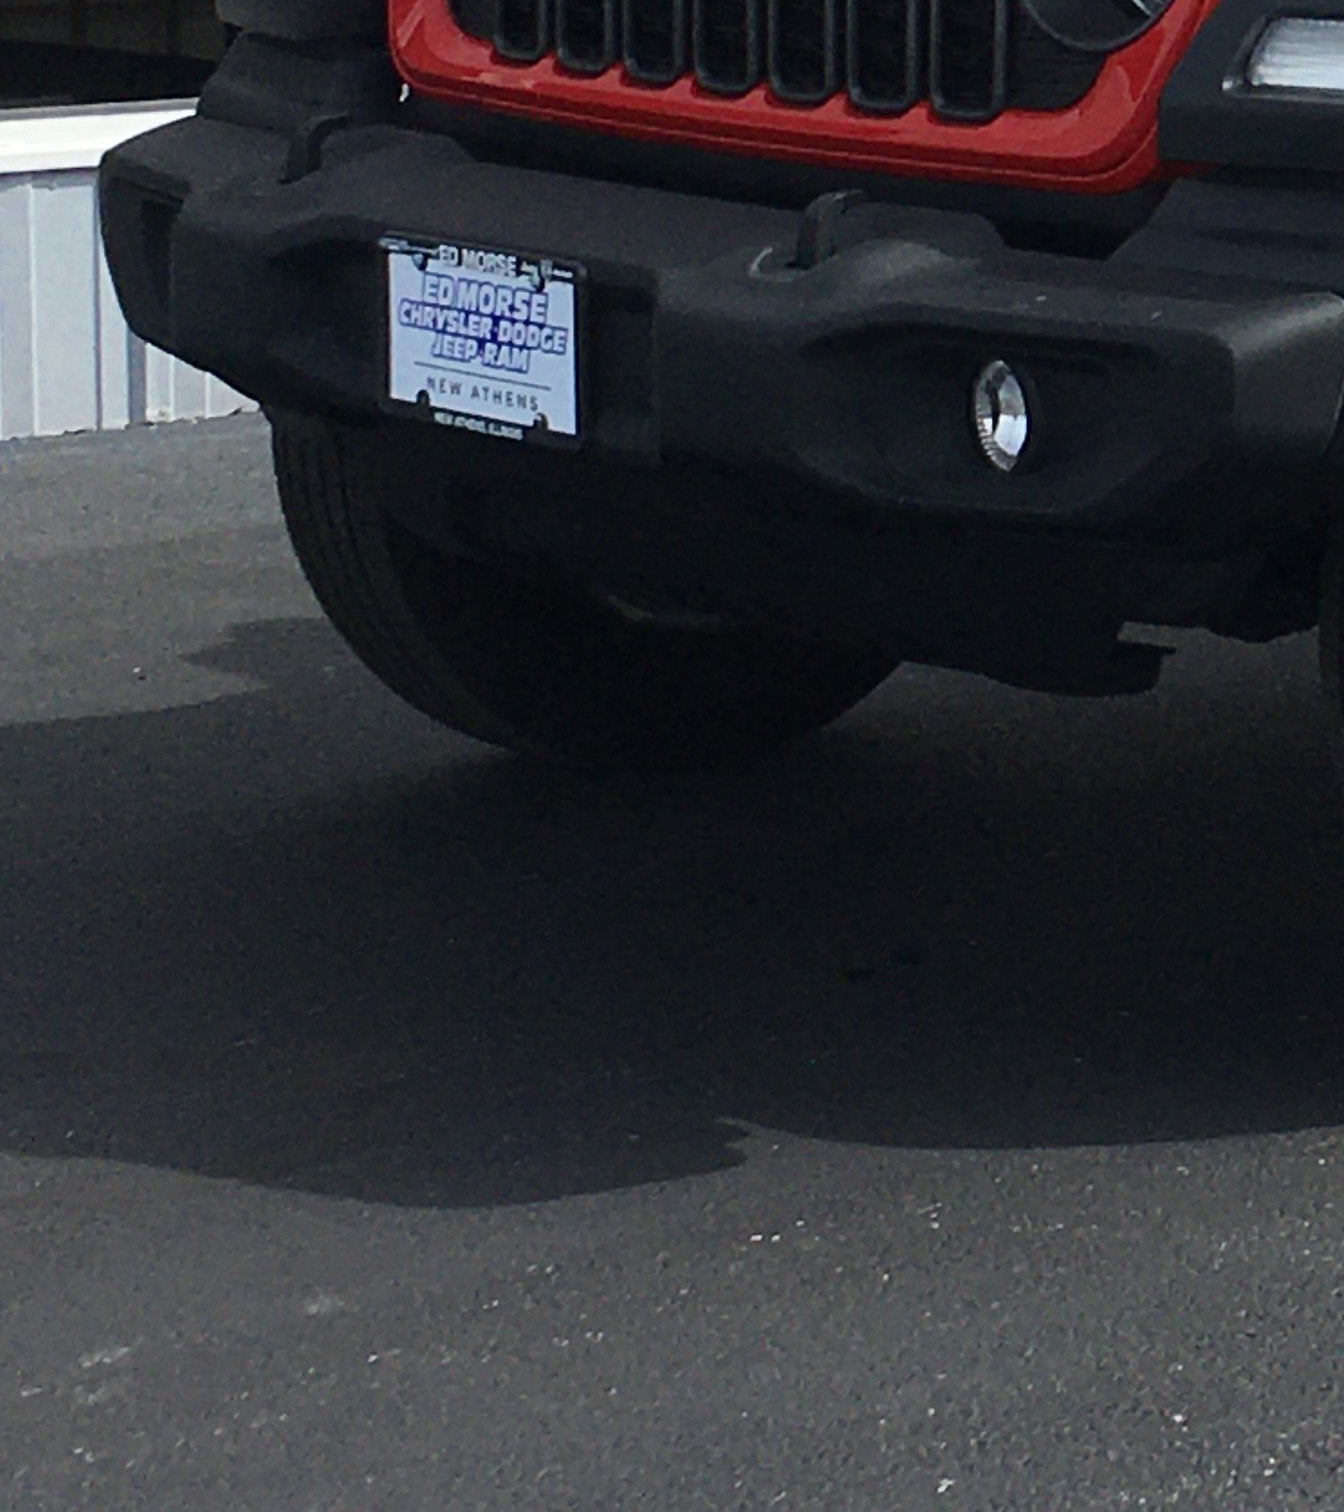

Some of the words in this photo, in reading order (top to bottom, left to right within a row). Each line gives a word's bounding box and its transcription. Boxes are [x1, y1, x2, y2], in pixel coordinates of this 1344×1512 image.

[438, 244, 459, 267] ED
[462, 249, 517, 277] MORSE
[424, 272, 454, 306] ED
[454, 277, 548, 325] MORSE
[399, 298, 494, 340] CHRYSLER
[498, 319, 569, 355] DODGE
[430, 332, 479, 363] JEEP
[481, 341, 530, 375] RAM
[426, 376, 463, 396] NEW
[470, 384, 540, 413] ATHENS
